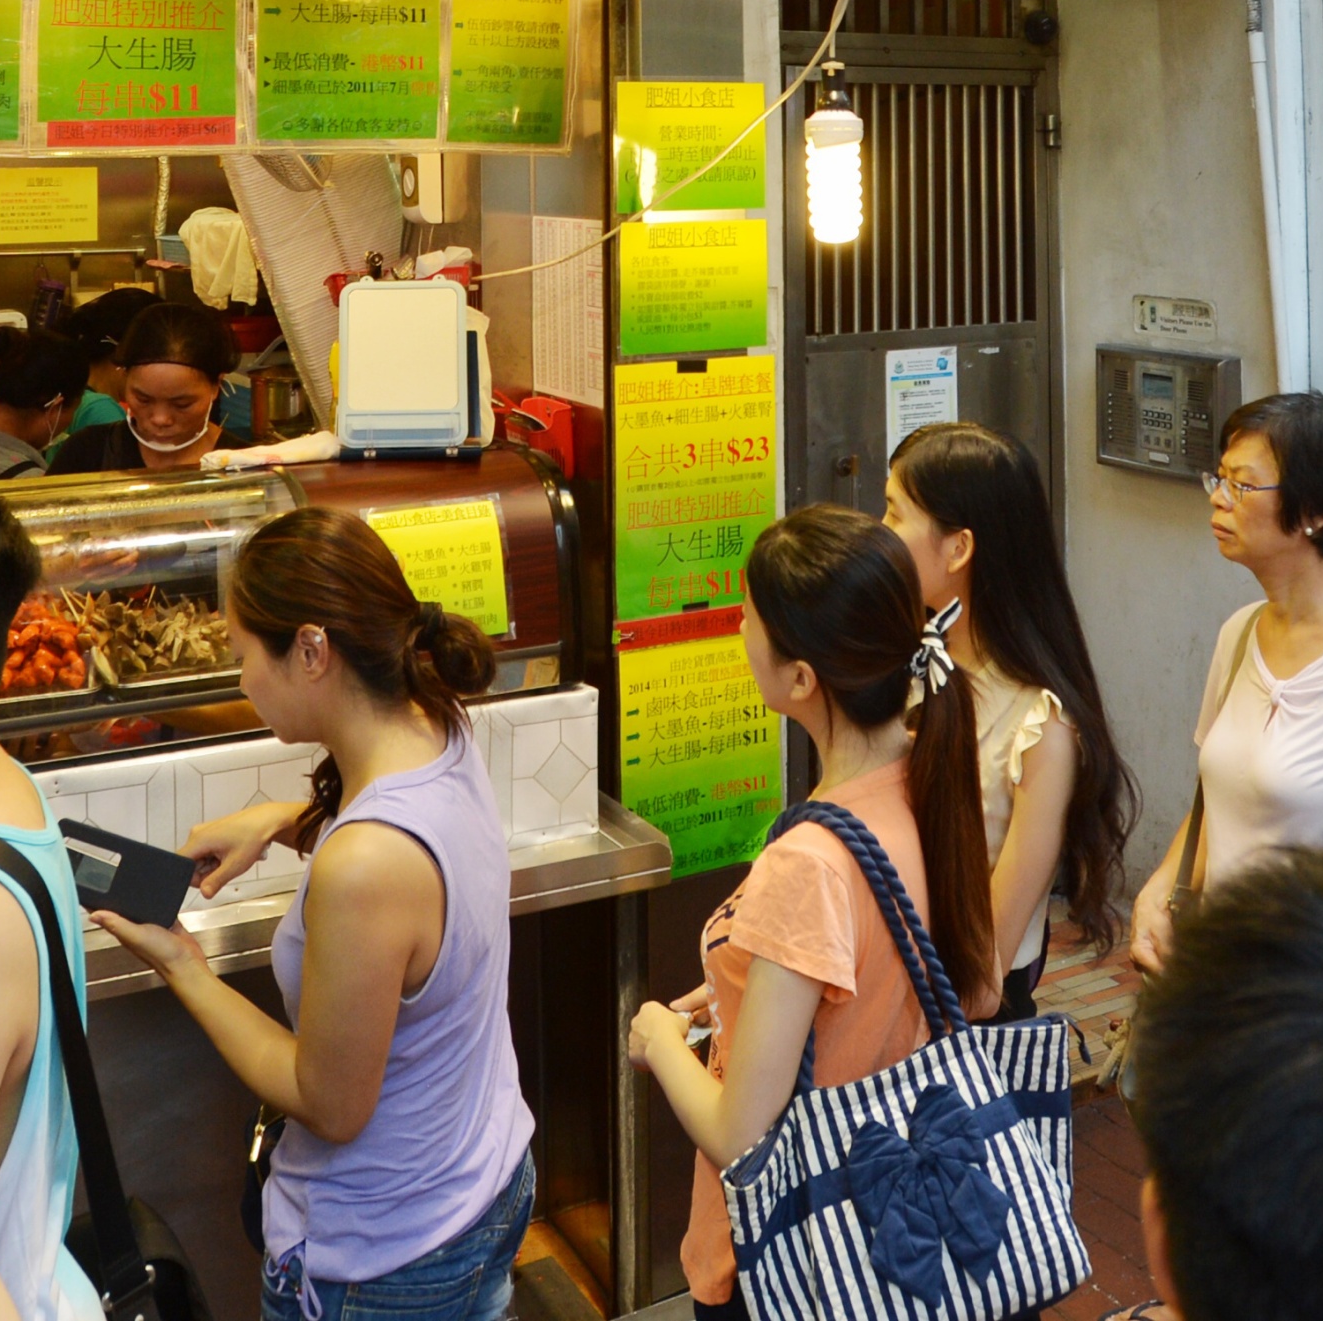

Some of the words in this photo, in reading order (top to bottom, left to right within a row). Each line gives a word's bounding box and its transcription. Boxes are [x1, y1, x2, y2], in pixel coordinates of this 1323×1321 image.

[87, 35, 197, 72] 大生腸
[74, 79, 202, 117] 每串$11
[645, 86, 736, 109] 肥姐小食店
[647, 225, 739, 249] 肥姐小食店
[622, 436, 770, 481] 合共3串$23
[625, 487, 767, 530] 肥姐特別推介
[656, 523, 745, 567] 大生腸
